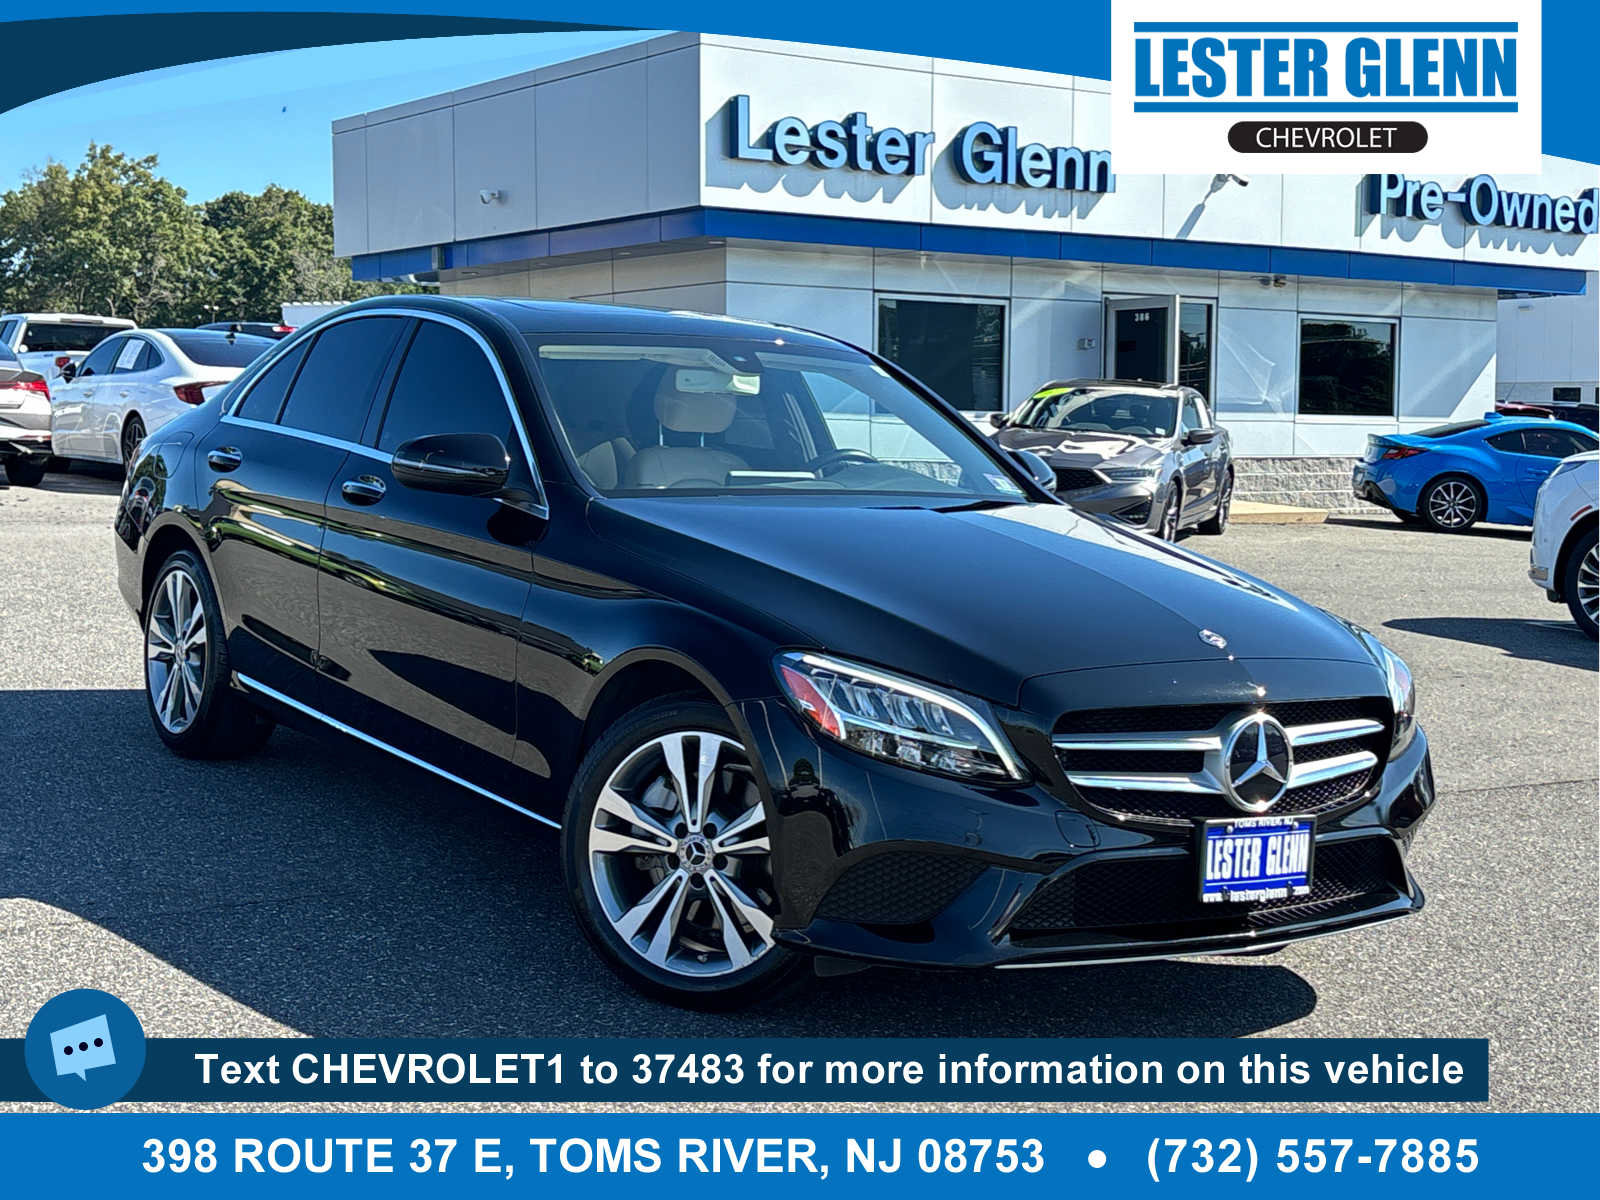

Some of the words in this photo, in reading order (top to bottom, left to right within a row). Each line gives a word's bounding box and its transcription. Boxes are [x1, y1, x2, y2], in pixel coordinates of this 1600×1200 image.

[733, 94, 935, 176] Lester
[957, 121, 1116, 193] Glenn
[1374, 174, 1599, 234] Pre-Owned
[1206, 837, 1262, 881] LESTER
[1265, 833, 1310, 876] GLENN
